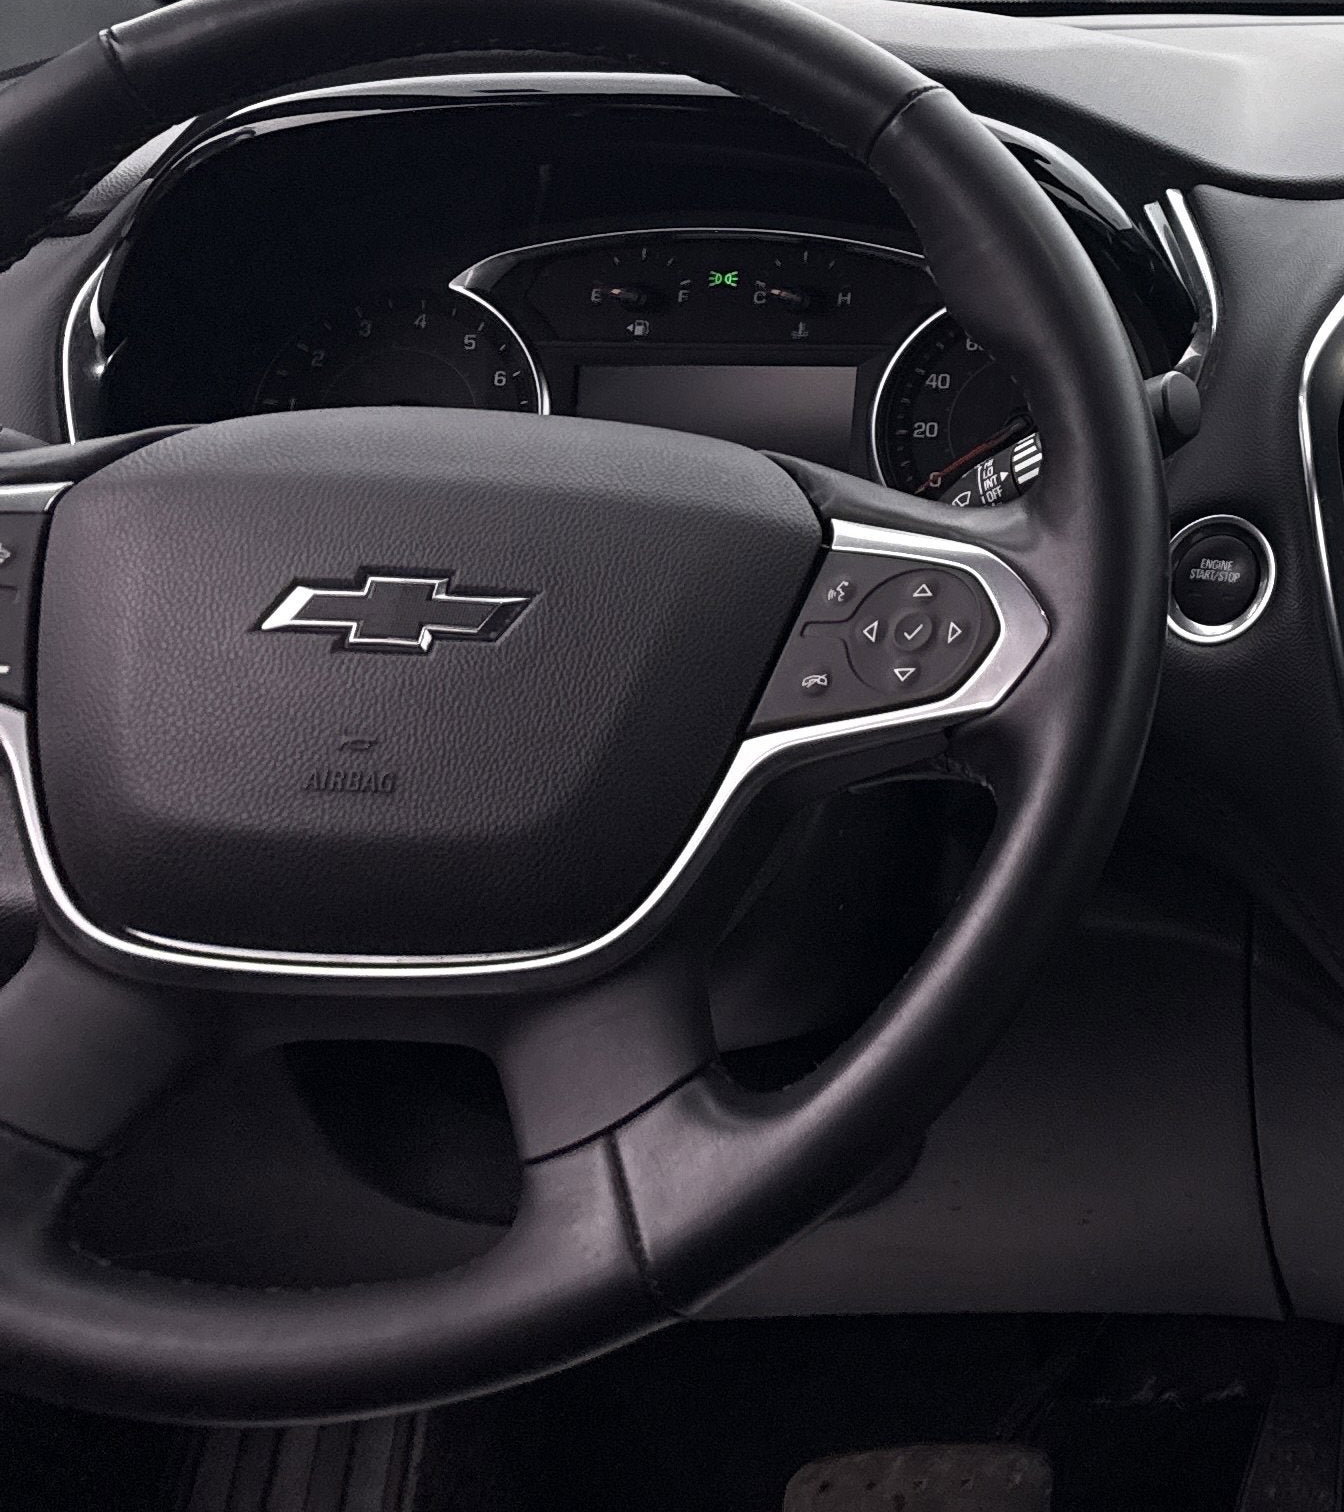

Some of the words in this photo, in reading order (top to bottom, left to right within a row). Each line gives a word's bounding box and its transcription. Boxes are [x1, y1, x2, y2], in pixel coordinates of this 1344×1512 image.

[677, 289, 689, 303] F
[753, 291, 766, 305] C
[837, 292, 851, 306] H
[463, 333, 478, 352] 5
[493, 370, 507, 387] 6
[925, 374, 951, 390] 40
[913, 422, 938, 438] 20
[984, 474, 998, 492] INT
[986, 485, 1003, 502] OFF
[1200, 558, 1234, 571] ENGINE
[1190, 568, 1241, 583] START/STOP
[305, 769, 396, 792] AIRBAG
